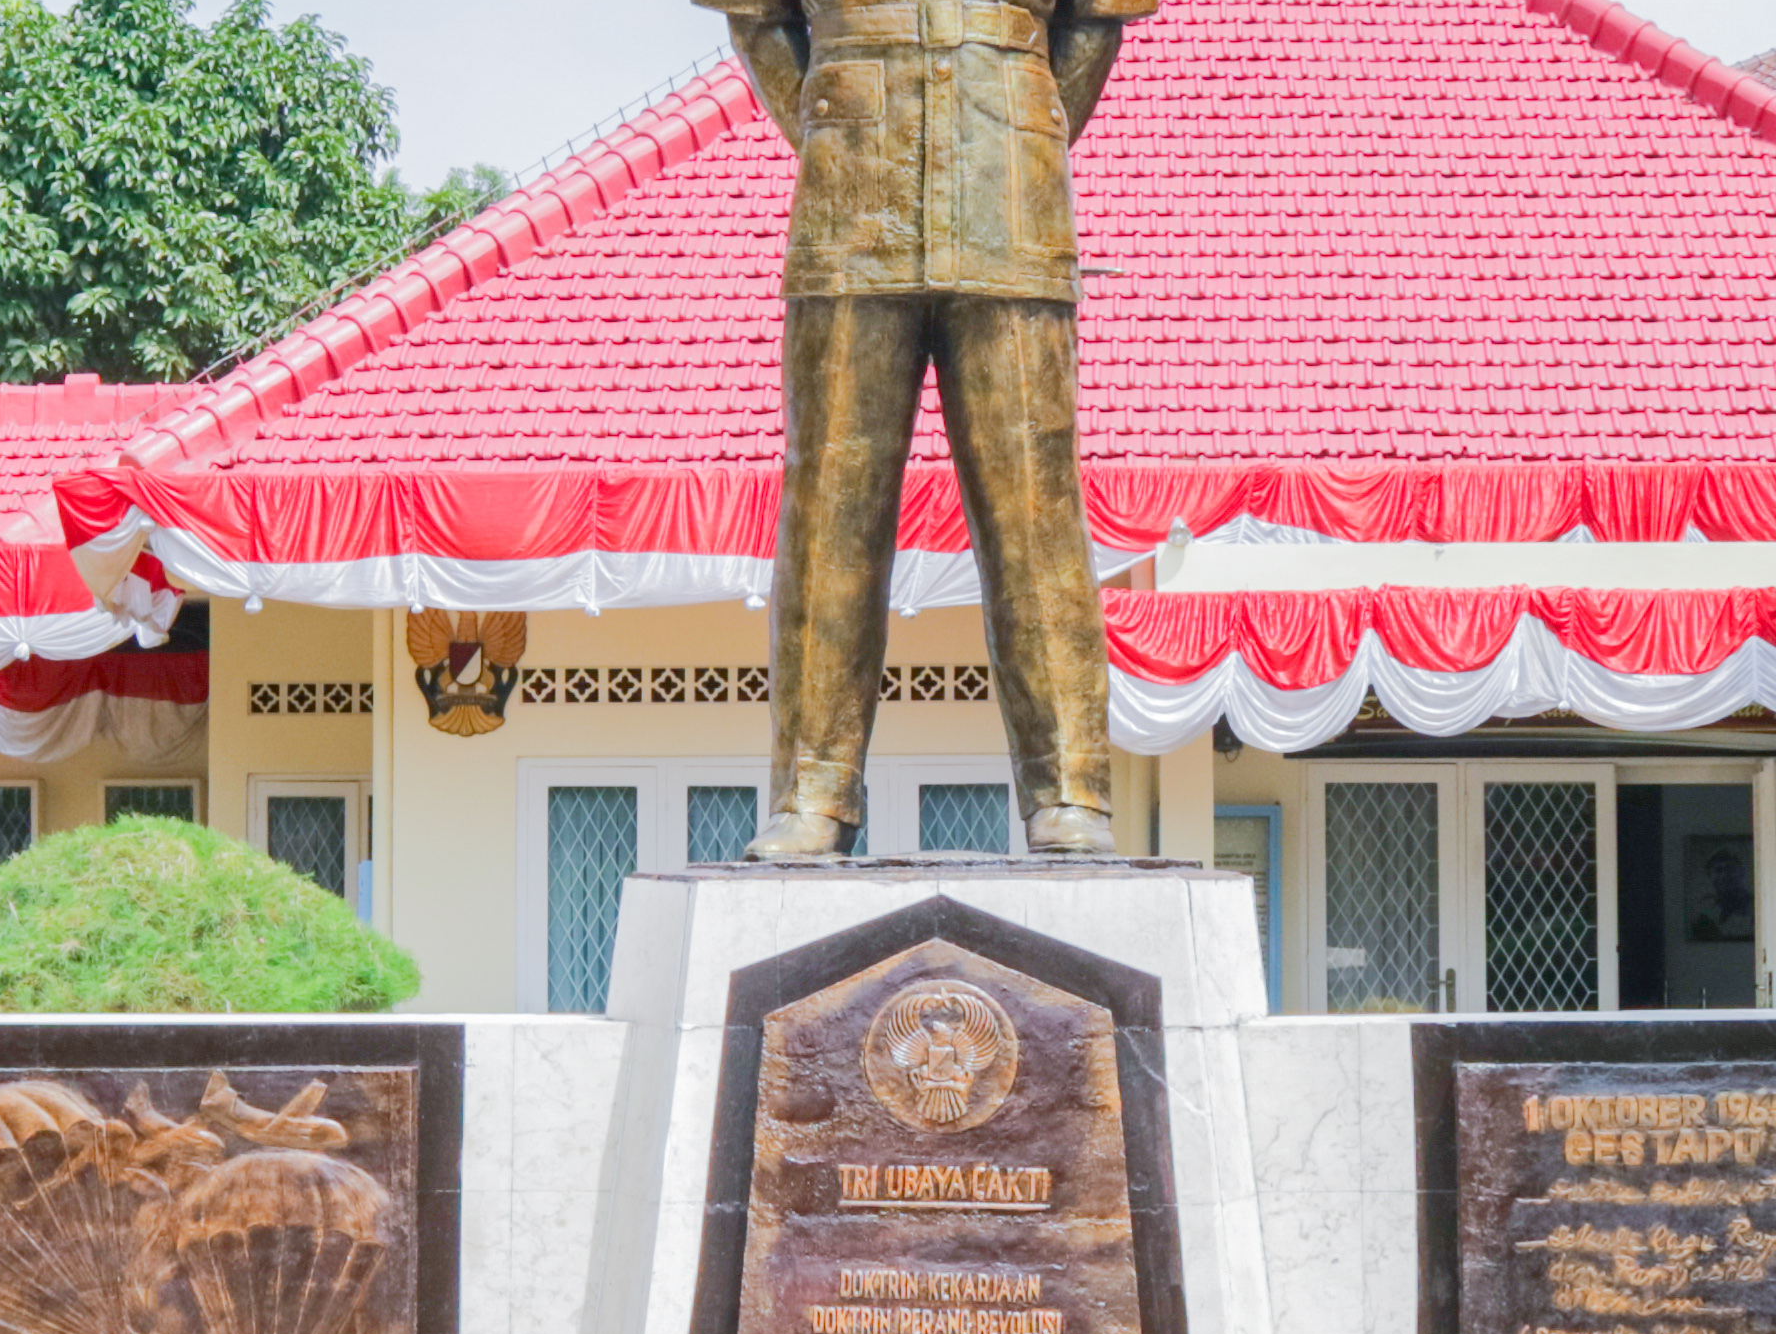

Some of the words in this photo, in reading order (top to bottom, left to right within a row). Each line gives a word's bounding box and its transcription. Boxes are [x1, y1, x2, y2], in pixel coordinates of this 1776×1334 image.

[1548, 1094, 1708, 1131] OKTOBER
[837, 1162, 879, 1200] TRI
[886, 1164, 968, 1200] UBAYA
[840, 1268, 919, 1300] DOKTRIN
[927, 1270, 1043, 1302] KEKARJAAN
[812, 1304, 892, 1334] DOKTRIN
